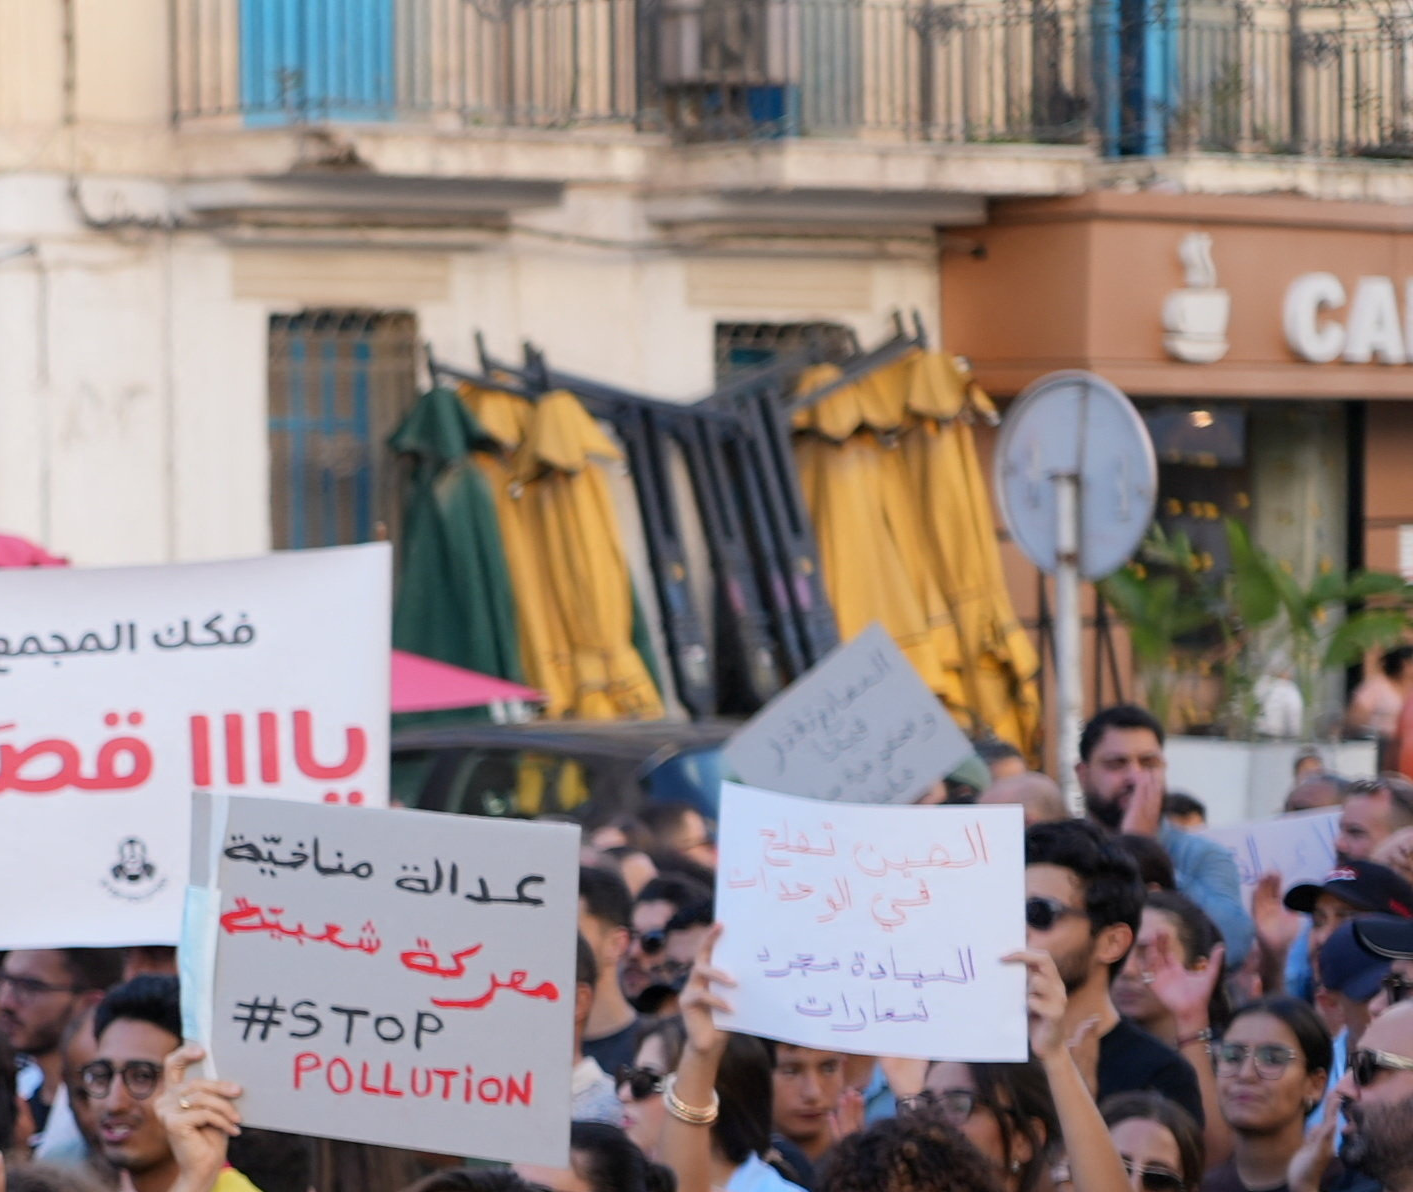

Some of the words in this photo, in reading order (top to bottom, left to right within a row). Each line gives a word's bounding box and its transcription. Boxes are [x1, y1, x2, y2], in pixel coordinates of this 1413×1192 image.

[1284, 271, 1413, 365] CA
[151, 611, 257, 651] فكك
[395, 858, 547, 908] عدالة
[871, 876, 931, 934] في
[399, 937, 560, 1012] معركة
[850, 945, 976, 989] السيادة
[232, 995, 445, 1051] #STOP
